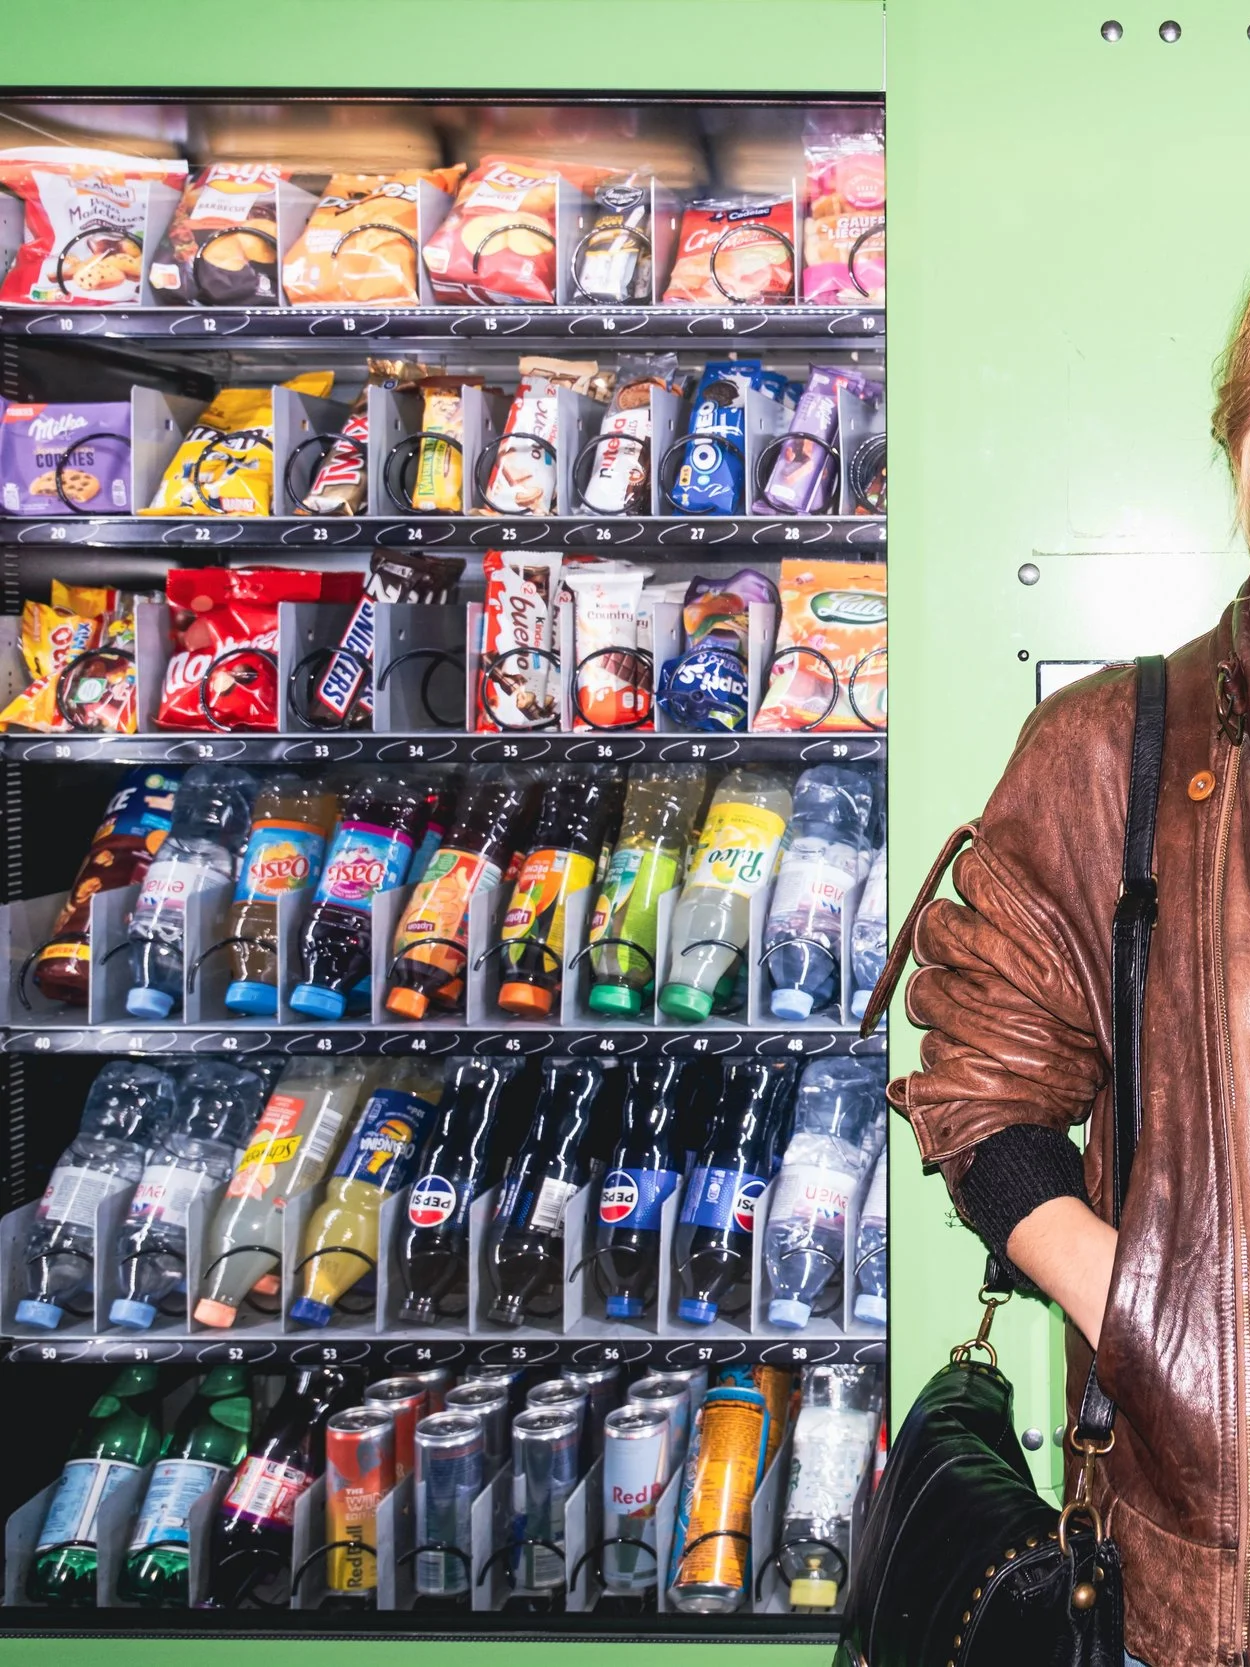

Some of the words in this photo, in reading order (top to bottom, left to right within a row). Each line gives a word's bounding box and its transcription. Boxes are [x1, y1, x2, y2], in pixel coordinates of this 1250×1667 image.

[60, 319, 73, 330] 10
[204, 319, 216, 331] 12
[343, 317, 355, 330] 13
[485, 319, 496, 330] 15
[603, 319, 615, 330] 16
[722, 319, 734, 330] 18
[862, 317, 875, 329] 19
[28, 413, 88, 441] Milka
[52, 528, 66, 540] 20
[196, 528, 210, 540] 22
[314, 528, 328, 540] 23
[409, 529, 422, 540] 24
[503, 529, 516, 540] 25
[597, 529, 611, 540] 26
[691, 528, 705, 539] 27
[785, 528, 799, 539] 28
[879, 527, 887, 540] 2
[56, 746, 70, 757] 30
[199, 745, 213, 757] 32
[315, 745, 329, 756] 33
[410, 746, 423, 756] 34
[504, 745, 517, 756] 35
[598, 745, 612, 756] 36
[692, 745, 706, 756] 37
[833, 745, 848, 756] 39
[251, 856, 310, 882] Oasis
[327, 858, 386, 884] Oasis
[708, 847, 763, 885] Pulco
[812, 880, 845, 902] vian
[406, 921, 436, 933] Lipton
[35, 1037, 50, 1049] 40
[128, 1037, 142, 1049] 41
[222, 1038, 237, 1049] 42
[317, 1039, 331, 1050] 43
[412, 1040, 426, 1049] 44
[506, 1039, 520, 1050] 45
[600, 1040, 614, 1050] 46
[694, 1039, 708, 1050] 47
[788, 1039, 803, 1051] 48
[411, 1194, 453, 1212] PEPSI
[42, 1347, 56, 1358] 50
[136, 1348, 148, 1359] 51
[229, 1348, 243, 1359] 52
[324, 1349, 336, 1359] 53
[417, 1349, 431, 1359] 54
[513, 1348, 526, 1358] 55
[605, 1348, 619, 1359] 56
[699, 1348, 712, 1359] 57
[793, 1348, 807, 1359] 58
[613, 1487, 647, 1504] Red
